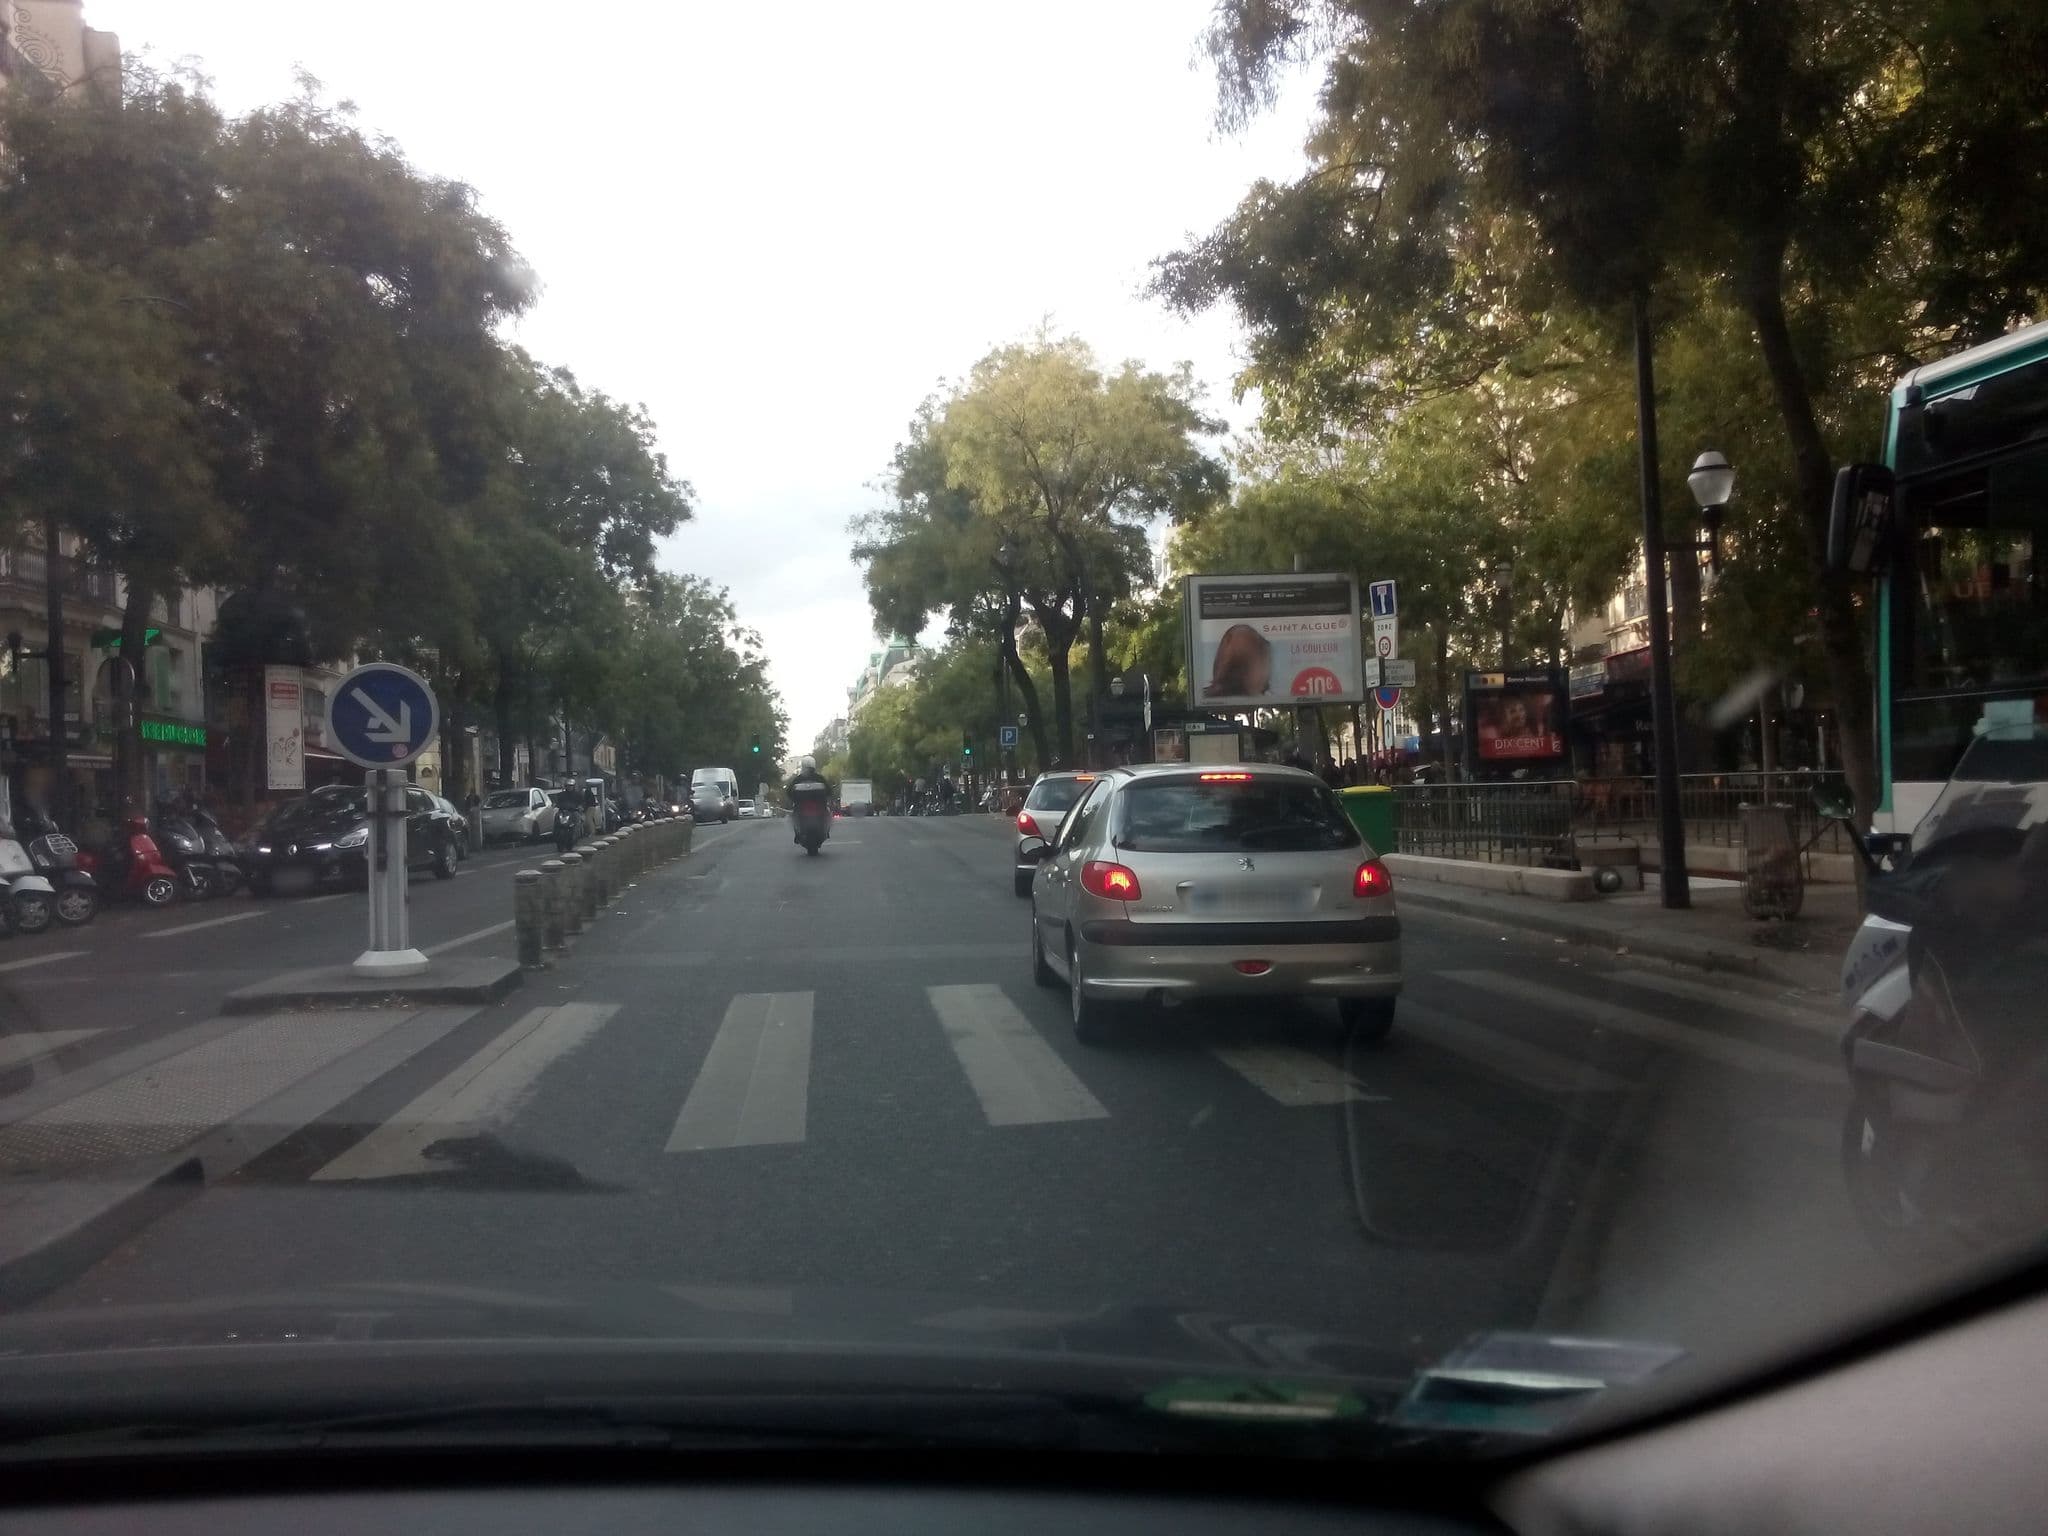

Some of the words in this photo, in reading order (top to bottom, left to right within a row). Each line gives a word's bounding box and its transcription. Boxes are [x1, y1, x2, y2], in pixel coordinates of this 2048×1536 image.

[1263, 624, 1298, 632] SAINT
[1300, 622, 1337, 631] ALGUE
[1005, 730, 1013, 742] P
